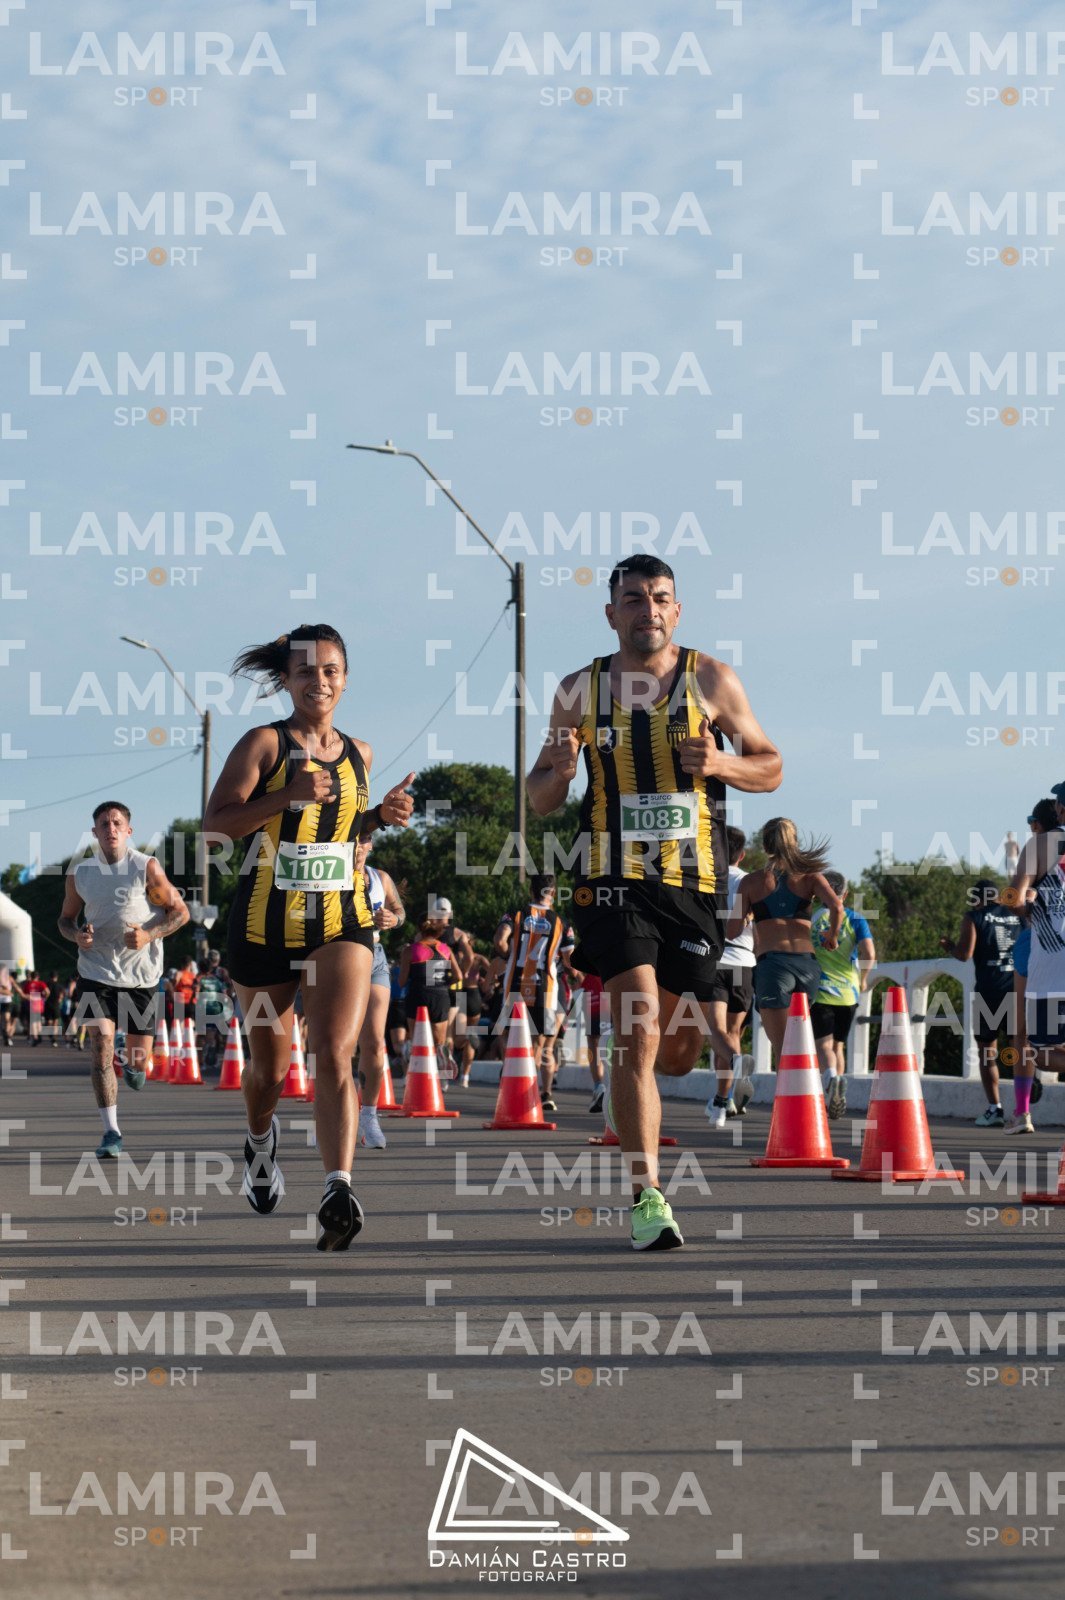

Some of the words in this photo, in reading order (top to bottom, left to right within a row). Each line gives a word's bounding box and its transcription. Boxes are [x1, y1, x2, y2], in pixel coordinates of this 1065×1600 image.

[630, 808, 684, 829] 1083
[289, 859, 338, 880] 1107
[679, 939, 707, 957] PUMA
